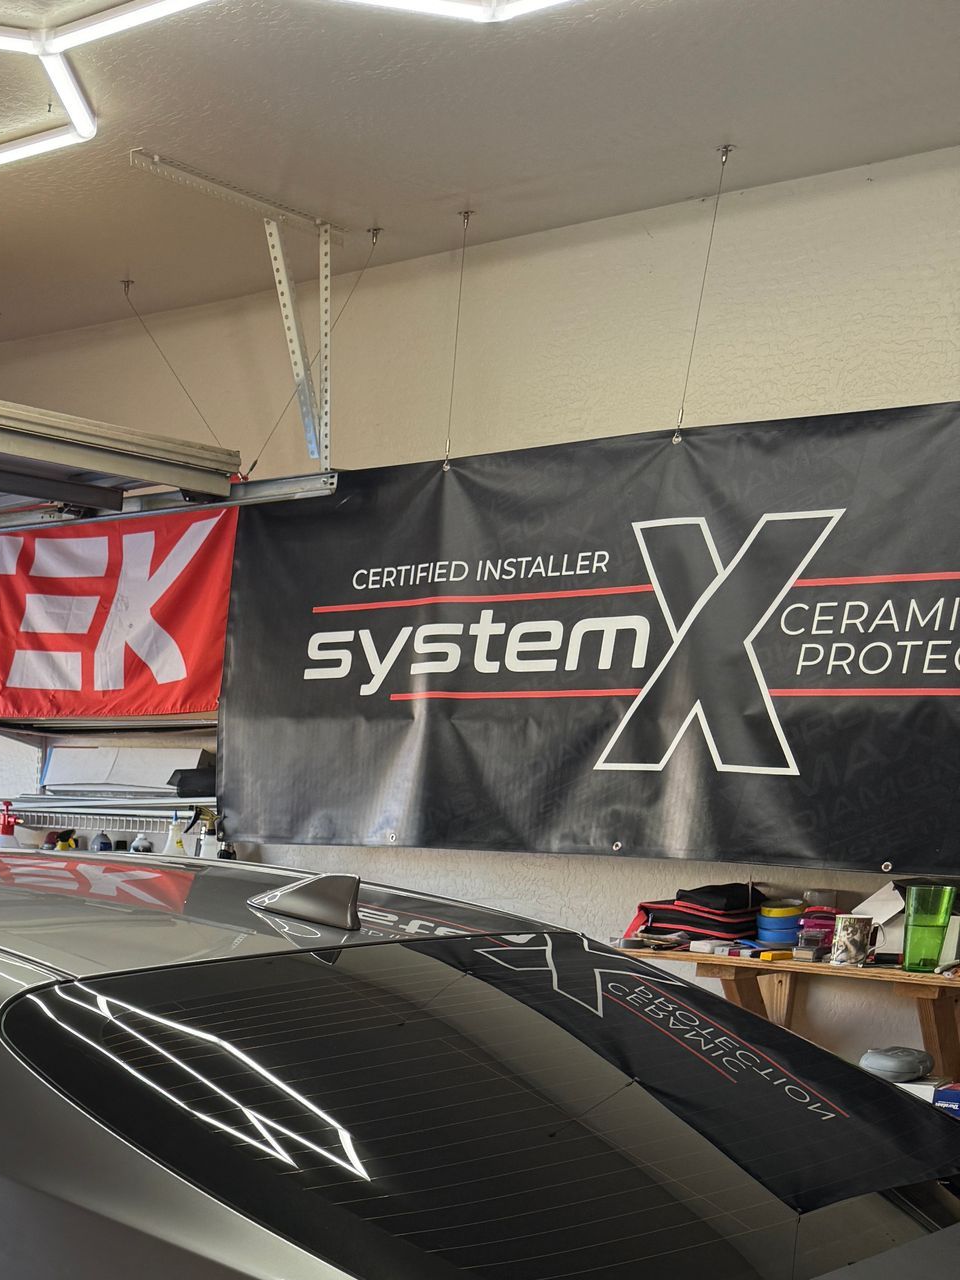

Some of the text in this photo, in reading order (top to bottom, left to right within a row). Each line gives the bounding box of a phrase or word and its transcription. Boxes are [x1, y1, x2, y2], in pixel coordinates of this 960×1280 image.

[352, 550, 610, 590] CERTIFIED INSTALLER
[795, 639, 960, 676] PROTE
